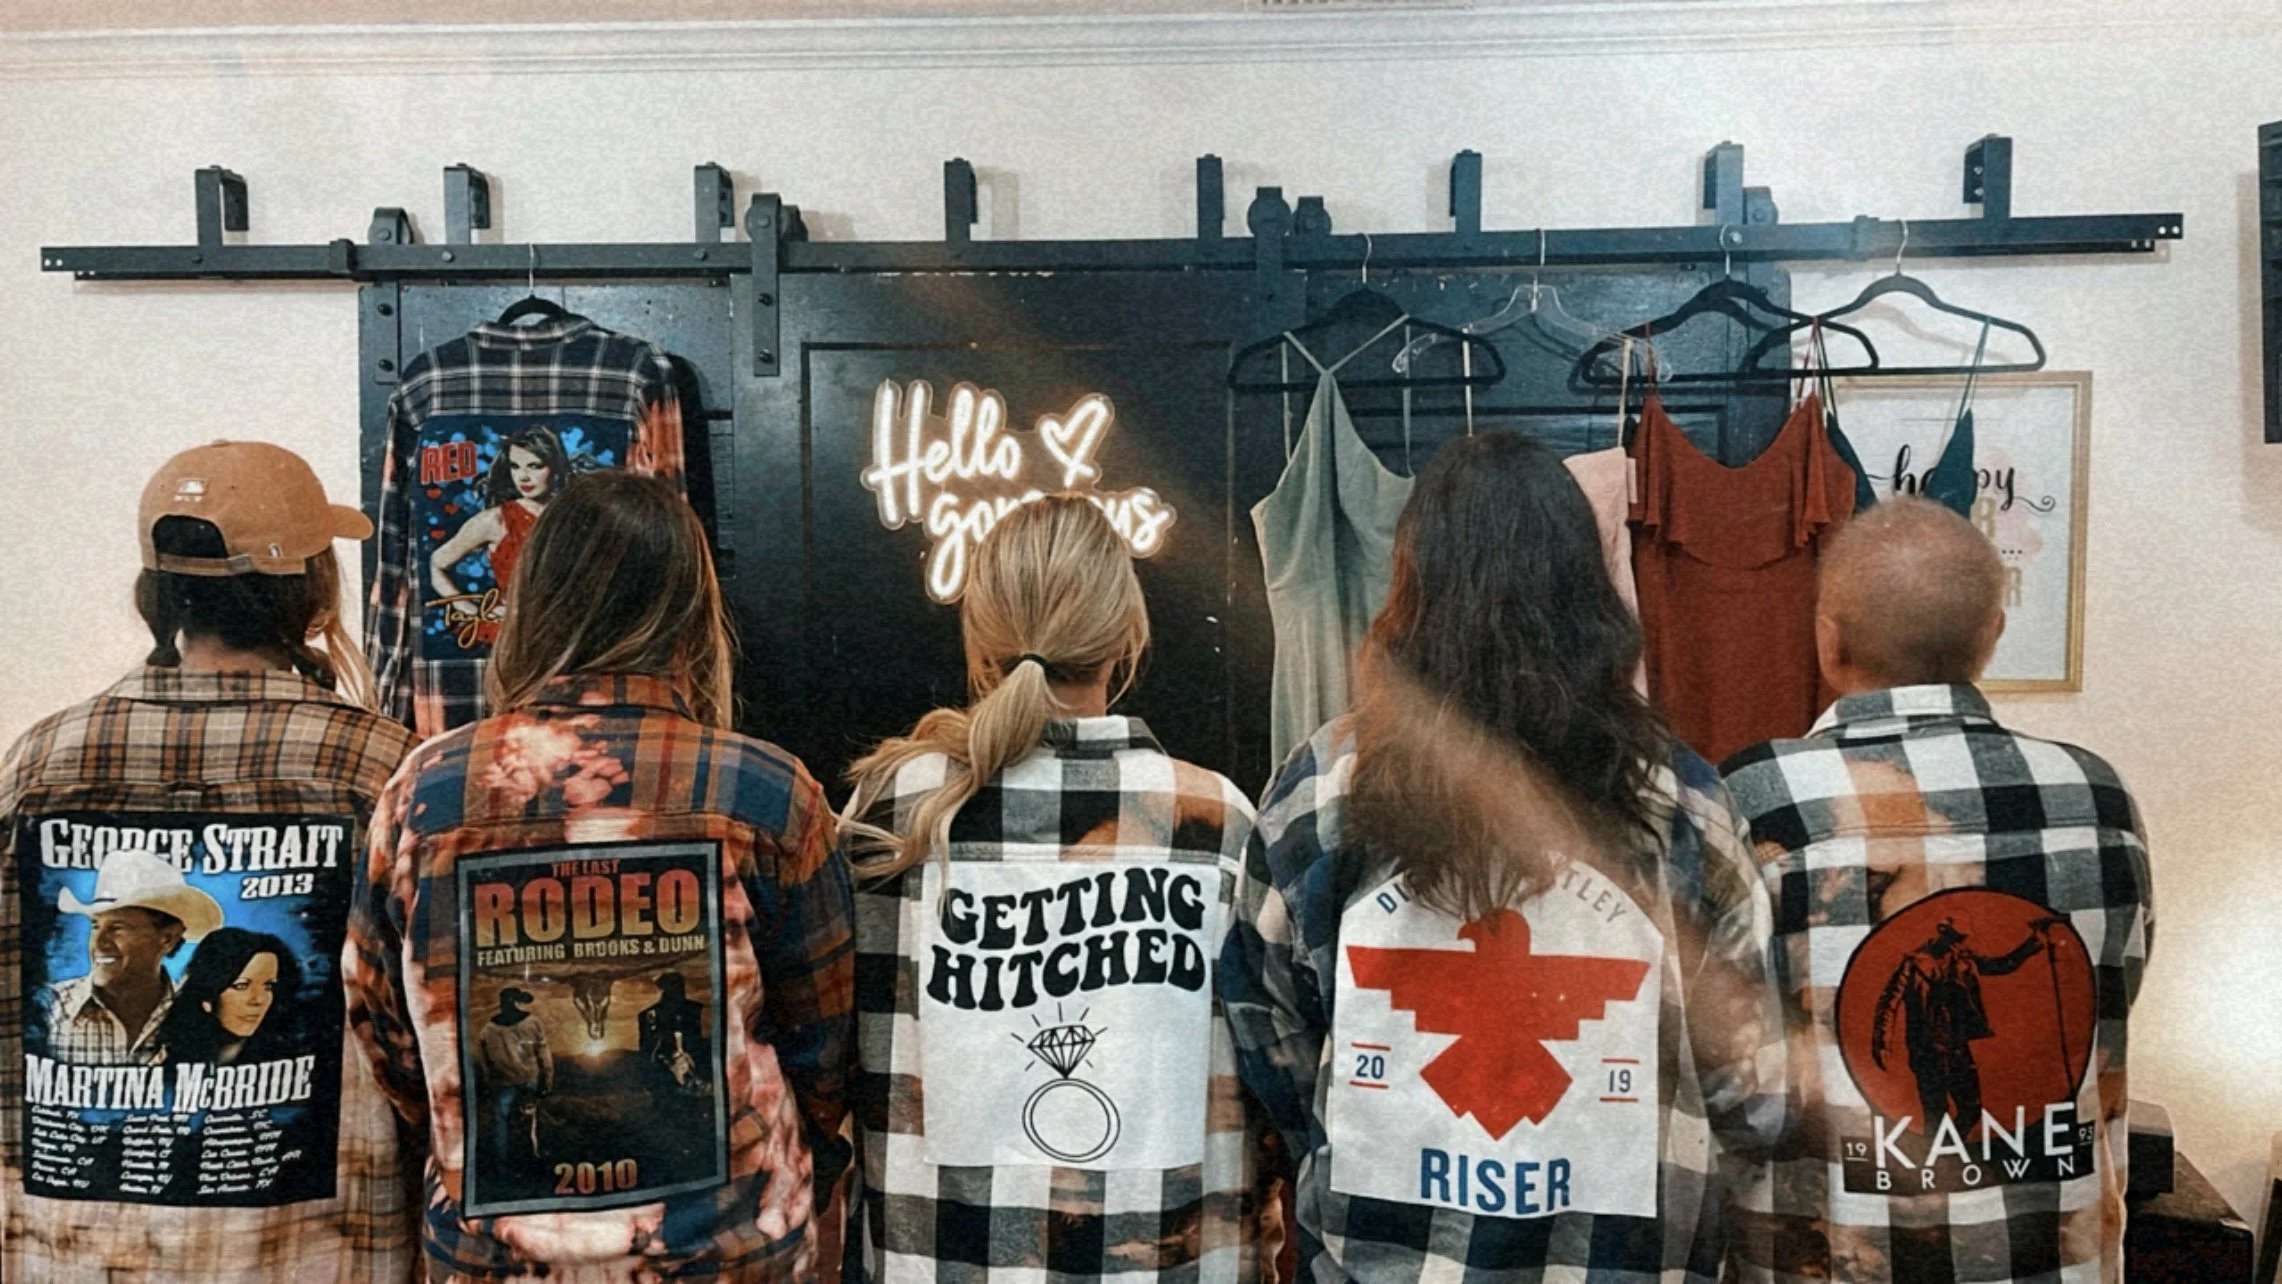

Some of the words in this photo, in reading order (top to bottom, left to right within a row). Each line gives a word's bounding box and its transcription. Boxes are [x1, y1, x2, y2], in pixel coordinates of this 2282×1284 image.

[420, 440, 478, 486] RED
[868, 382, 1022, 524] Hello
[202, 823, 344, 875] STRAIT
[552, 861, 578, 877] THE
[580, 858, 620, 875] LAST
[240, 874, 315, 899] 2013
[474, 869, 700, 947] RODEO
[941, 868, 1205, 949] GETTING
[1562, 867, 1628, 923] TLEY
[477, 943, 566, 967] FEATURING
[573, 940, 640, 959] BROOKS
[643, 939, 655, 955] &
[660, 935, 705, 953] DUNN
[926, 929, 1205, 1011] HITCHED
[25, 1054, 164, 1110] MARTINA
[1355, 1055, 1385, 1079] 20
[1608, 1069, 1632, 1093] 19
[1845, 1142, 1868, 1156] 19
[1874, 1102, 2075, 1169] KANE
[554, 1158, 638, 1194] 2010
[1420, 1148, 1571, 1214] RISER
[1876, 1155, 2075, 1190] BROWN
